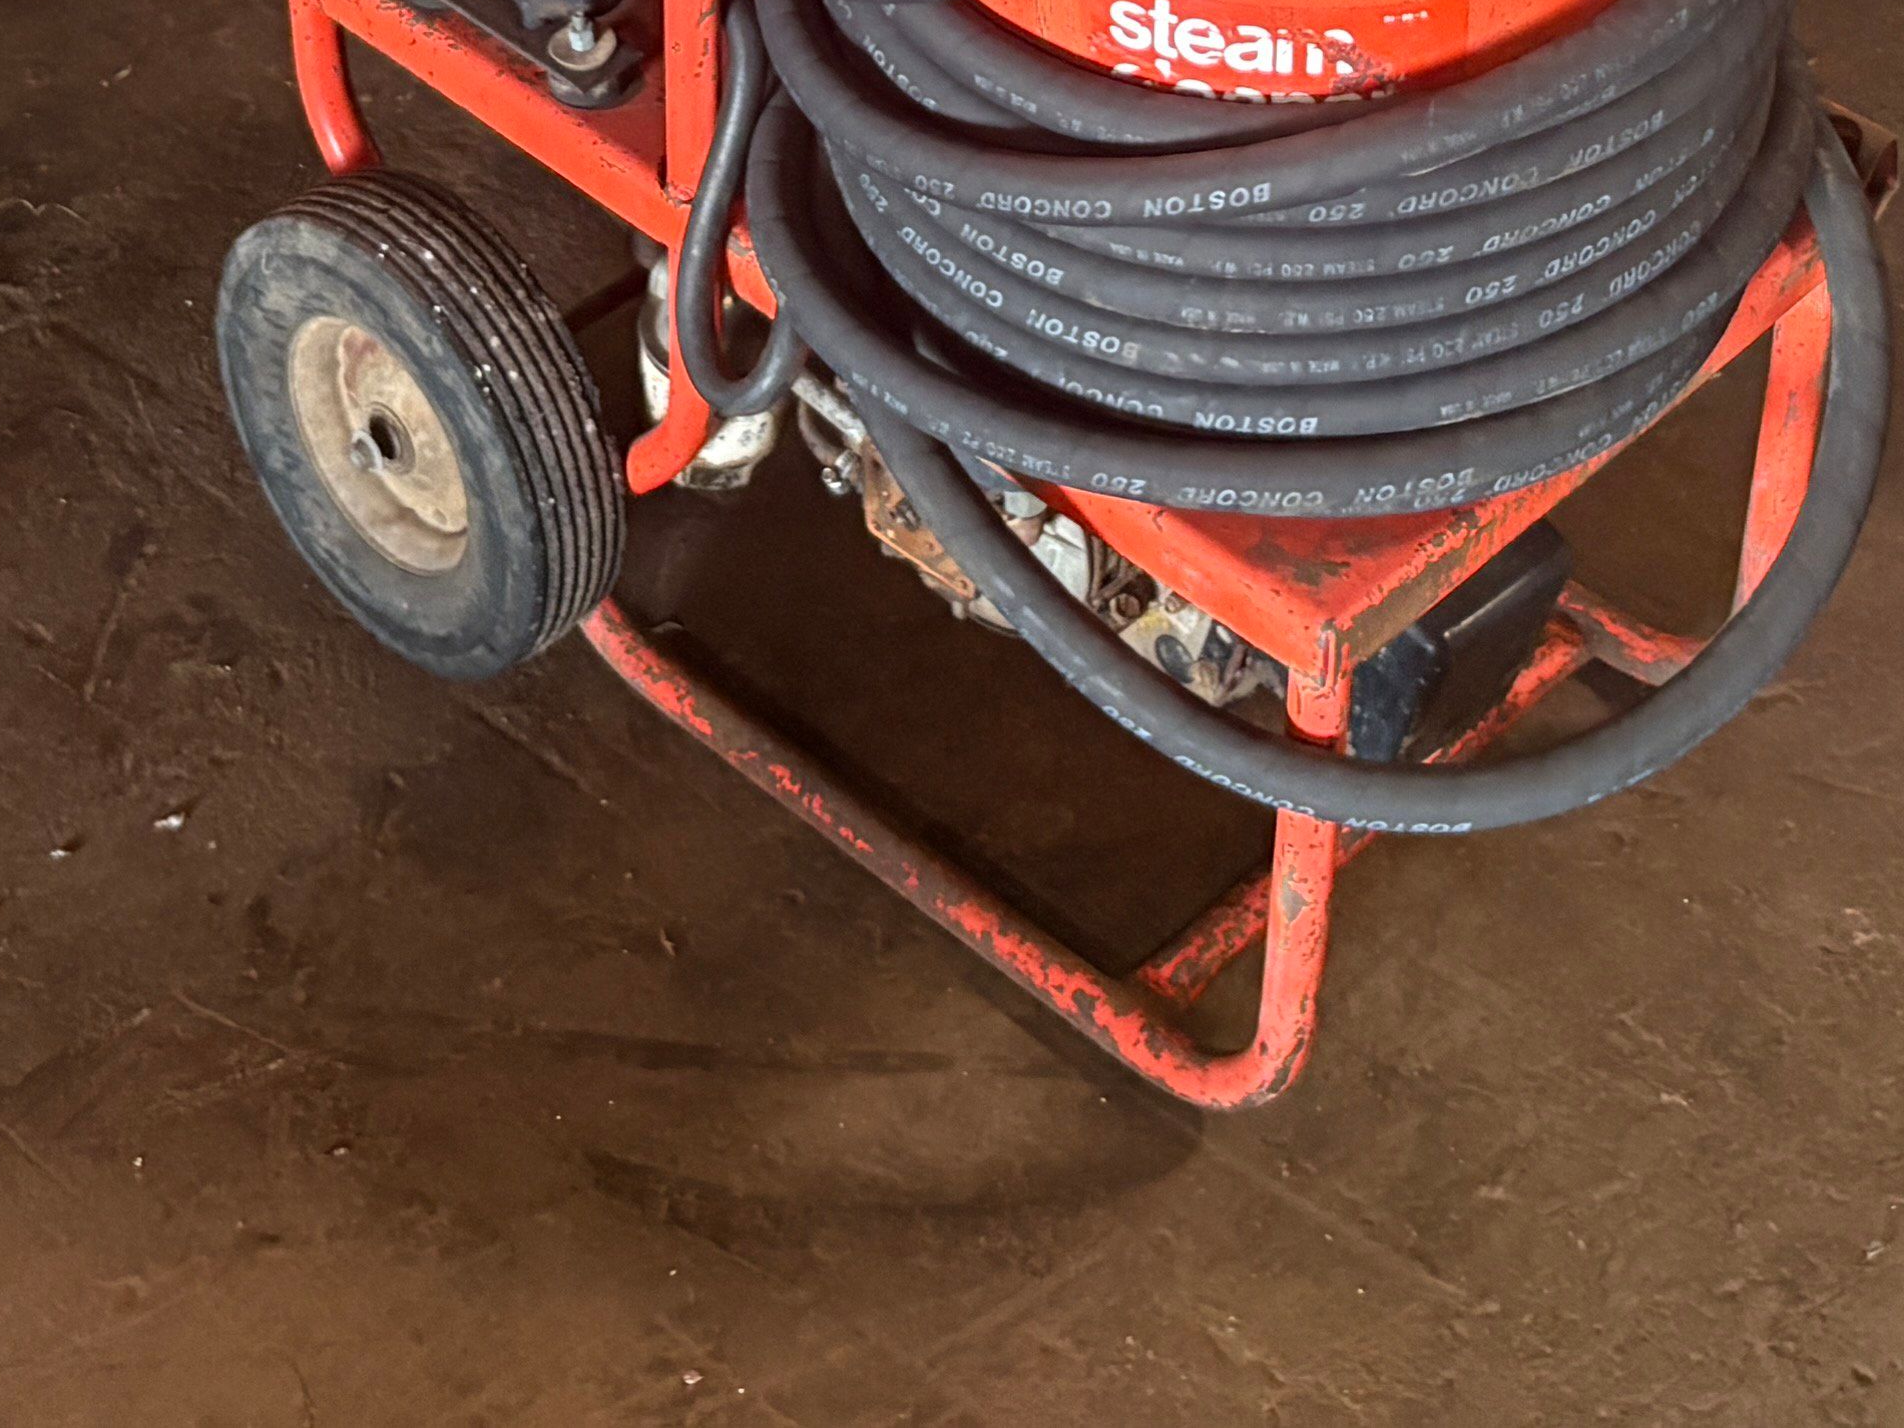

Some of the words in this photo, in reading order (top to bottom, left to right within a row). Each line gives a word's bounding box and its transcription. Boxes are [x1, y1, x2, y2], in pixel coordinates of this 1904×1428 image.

[914, 174, 955, 196] 250
[1142, 182, 1272, 218] BOSTON
[979, 191, 1113, 219] CONCORD
[1308, 202, 1367, 223] 250
[959, 223, 1064, 287] BOSTON
[1544, 209, 1656, 281] CONCORD
[898, 226, 1003, 308] CONCORD
[1465, 274, 1518, 305] 250
[1539, 292, 1585, 329] 250
[1026, 307, 1142, 361] BOSTON
[1194, 409, 1319, 435] BOSTON
[1176, 486, 1324, 511] CONCORD
[1357, 467, 1477, 506] BOSTON
[1173, 754, 1316, 816] CONCORD
